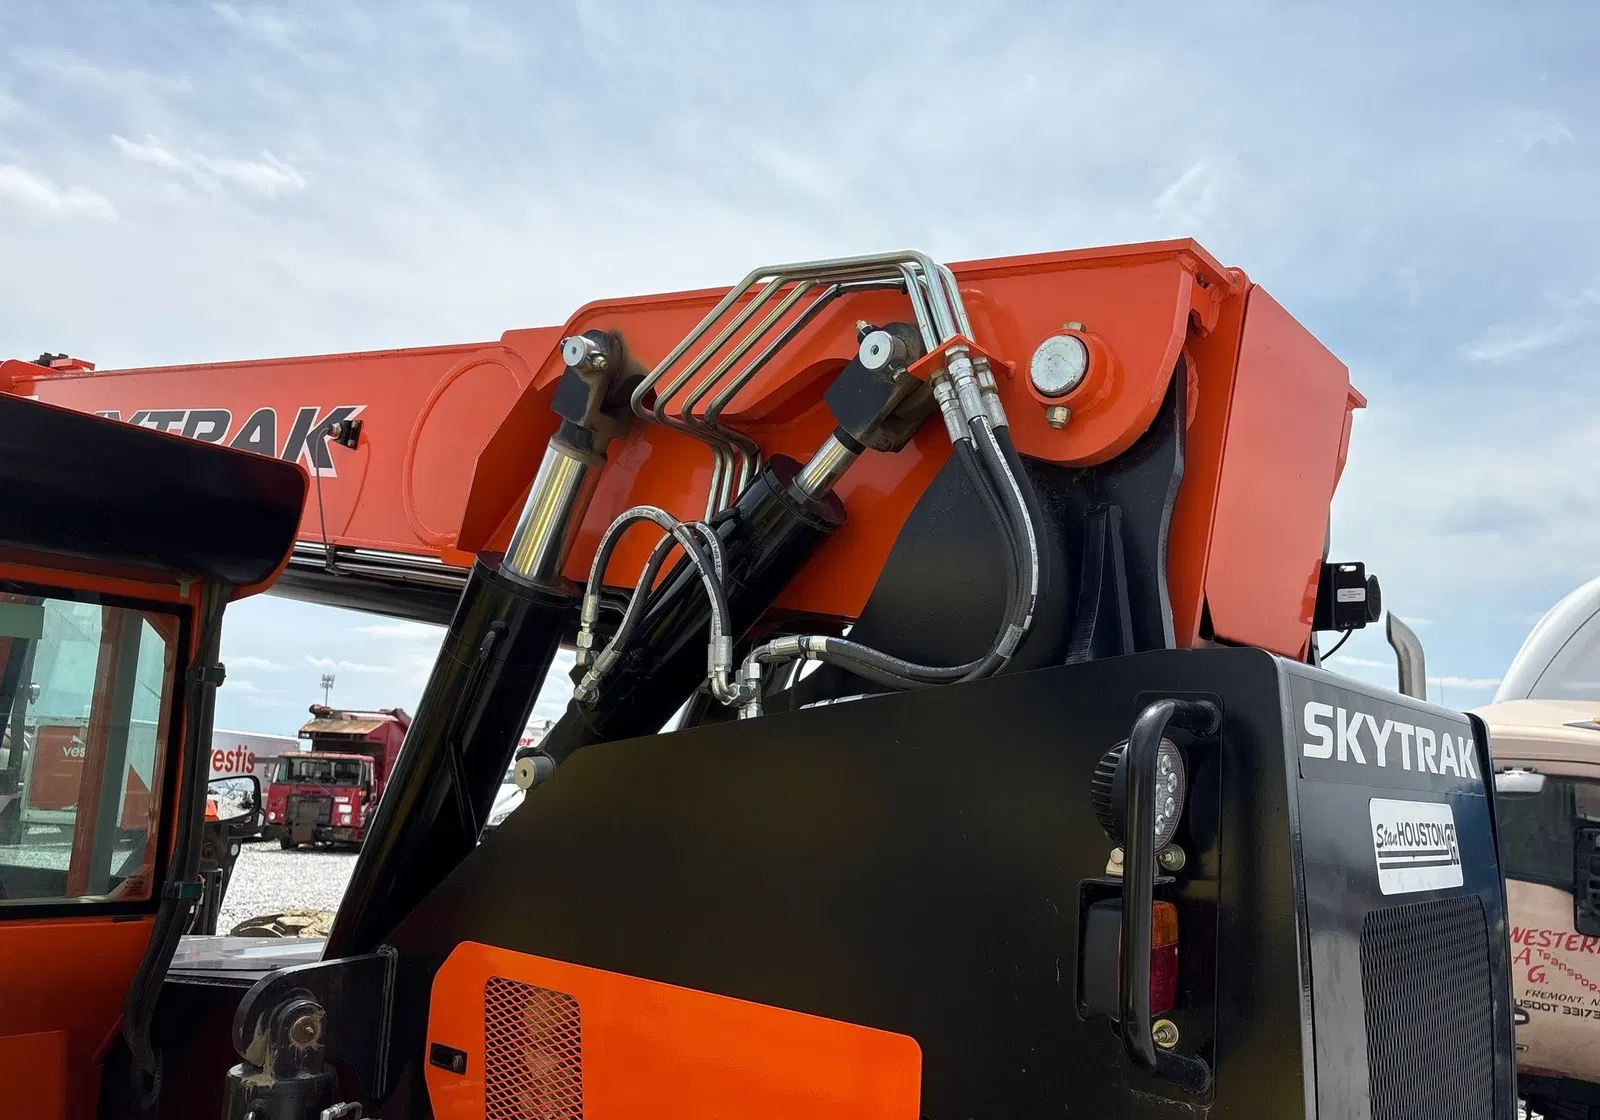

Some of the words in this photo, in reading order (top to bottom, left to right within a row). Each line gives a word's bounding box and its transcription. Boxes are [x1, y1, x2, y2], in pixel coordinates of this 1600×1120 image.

[1303, 701, 1477, 779] SKYTRAK
[211, 744, 256, 774] estis
[1396, 821, 1446, 847] HOUSTON
[1510, 926, 1600, 954] WESTER
[1514, 998, 1559, 1013] USDOT
